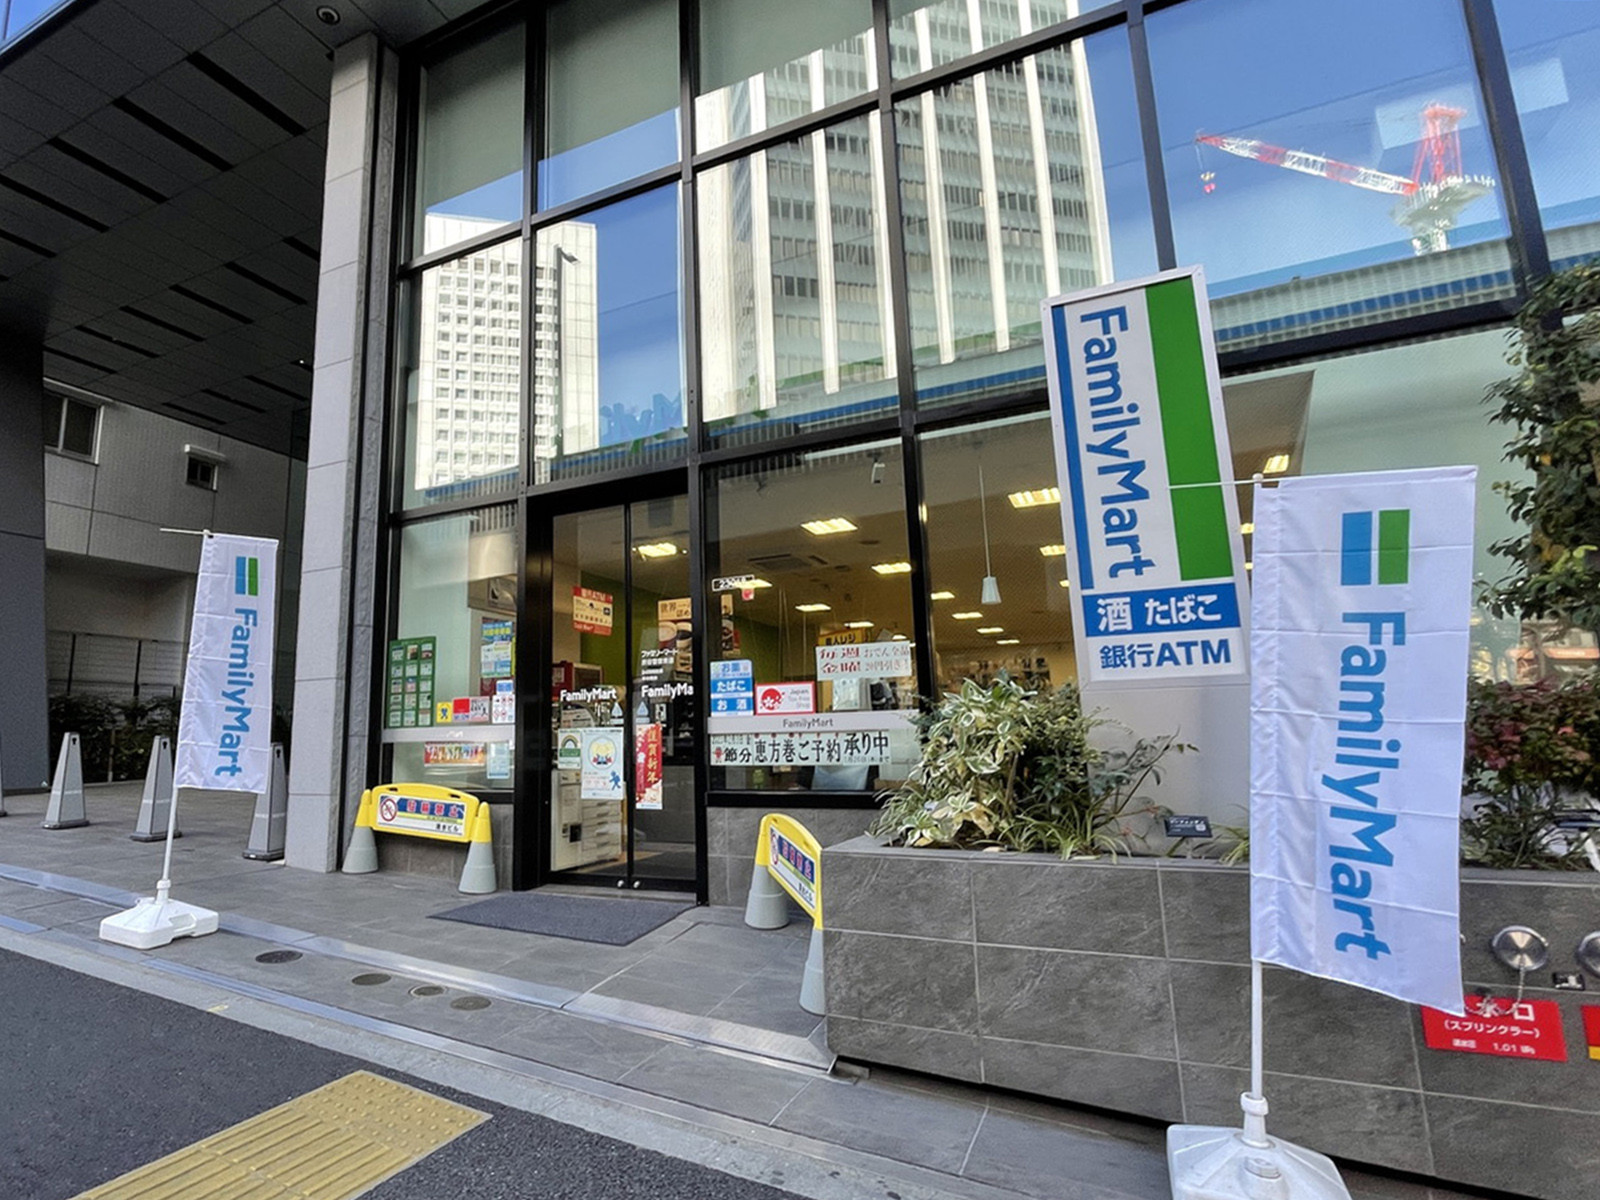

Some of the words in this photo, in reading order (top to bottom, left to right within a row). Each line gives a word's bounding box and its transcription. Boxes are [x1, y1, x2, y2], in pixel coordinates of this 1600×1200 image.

[1080, 305, 1157, 580] FamilyMart
[1097, 596, 1133, 632] 酒
[1144, 593, 1222, 626] たばこ
[1099, 638, 1232, 669] 銀行ATM
[214, 607, 258, 778] FamilyMart
[560, 687, 617, 703] FamilyMart
[716, 679, 746, 693] たばこ
[782, 717, 834, 730] FamilyMart
[1321, 610, 1407, 961] FamilyMart
